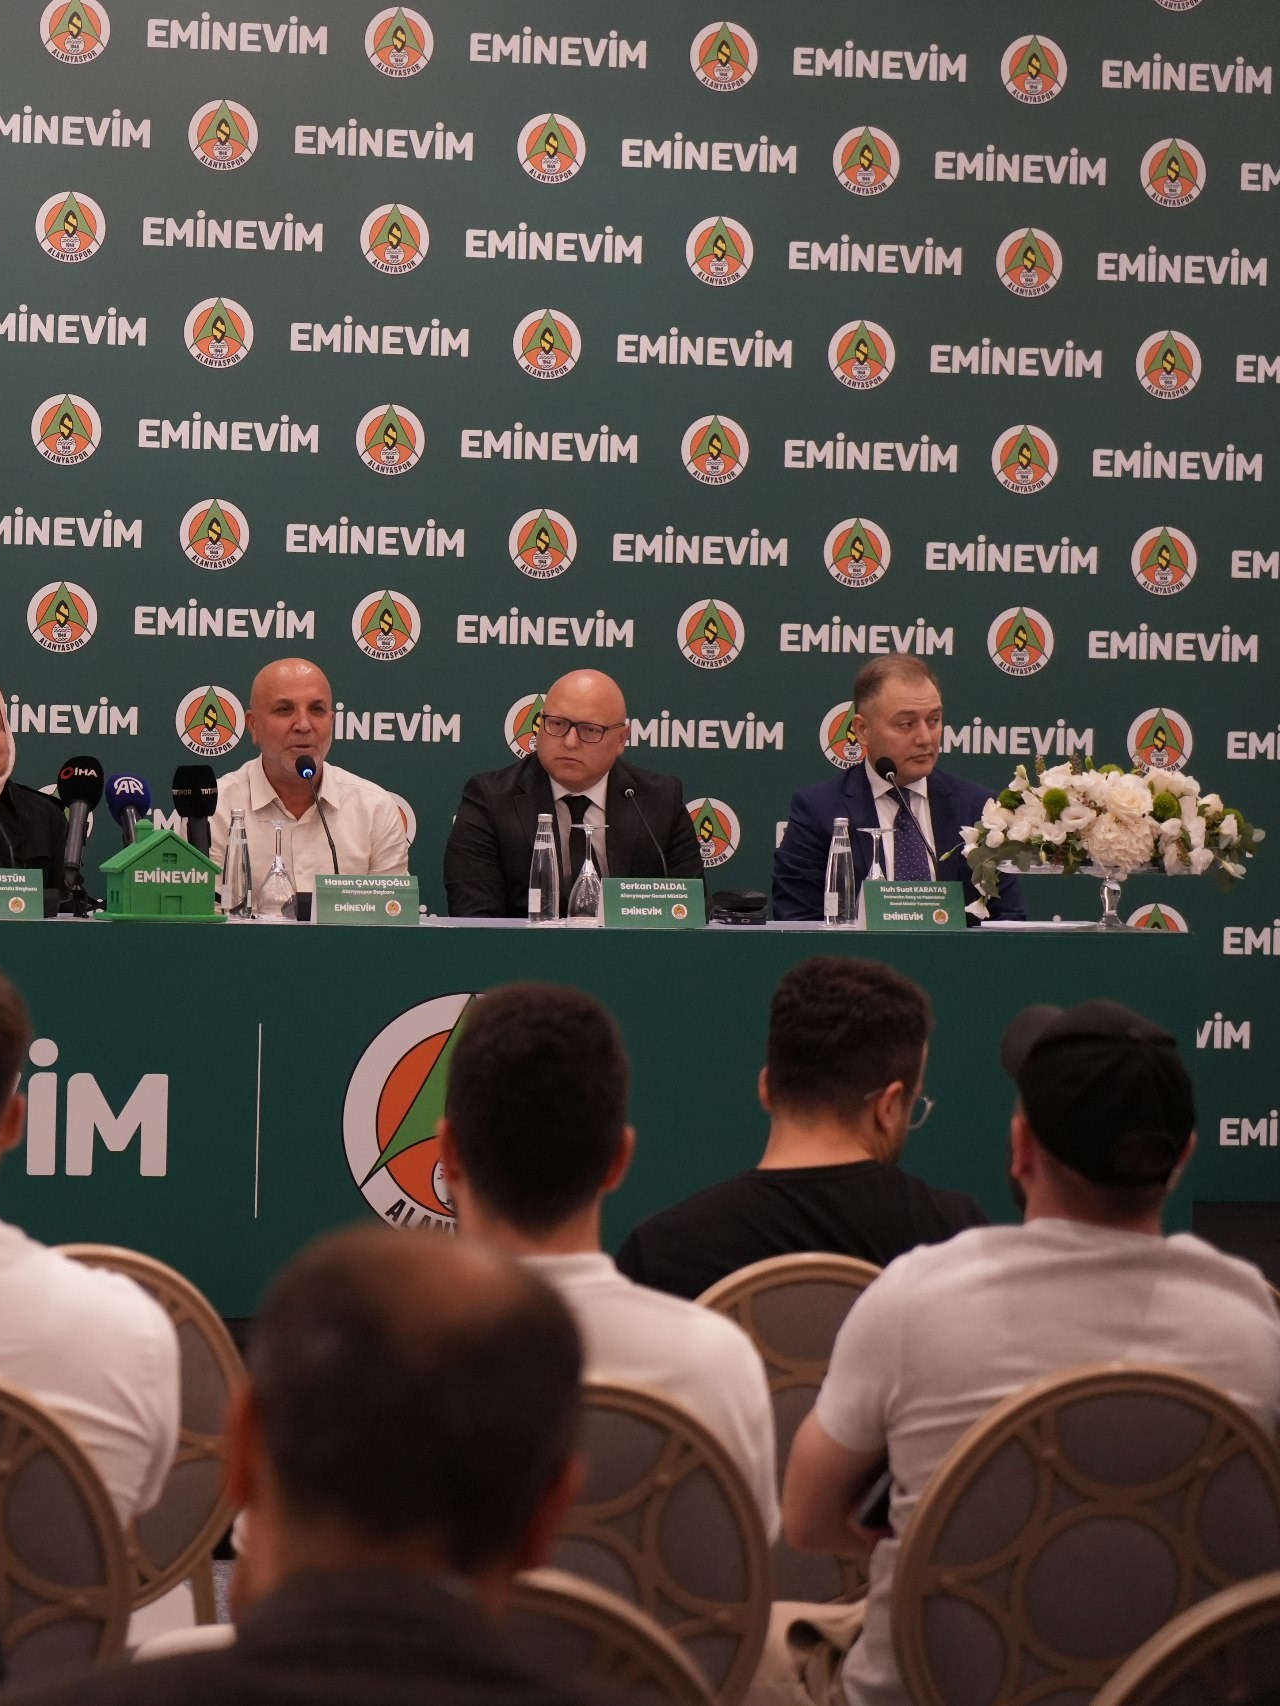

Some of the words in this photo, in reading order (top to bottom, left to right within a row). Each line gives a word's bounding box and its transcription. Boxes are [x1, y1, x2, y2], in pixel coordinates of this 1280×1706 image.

[147, 12, 327, 54] EMİNEVİM
[470, 26, 646, 69] EMİNEVİM
[793, 40, 966, 82] EMİNEVİM
[1102, 53, 1272, 94] EMİNEVİM
[295, 119, 473, 161] EMİNEVİM
[622, 132, 797, 174] EMİNEVİM
[935, 144, 1106, 185] EMİNEVİM
[143, 210, 323, 252] EMİNEVİM
[466, 222, 642, 264] EMİNEVİM
[47, 248, 93, 261] ALANYASPOR
[789, 234, 962, 275] EMİNEVİM
[1097, 245, 1267, 286] EMİNEVİM
[290, 315, 469, 357] EMİNEVİM
[617, 327, 792, 368] EMİNEVİM
[195, 353, 240, 367] ALANYASPOR
[930, 338, 1102, 378] EMİNEVİM
[139, 412, 318, 453] EMİNEVİM
[461, 422, 638, 463] EMİNEVİM
[784, 432, 957, 473] EMİNEVİM
[42, 450, 88, 464] ALANYASPOR
[1093, 442, 1262, 482] EMİNEVİM
[286, 516, 464, 557] EMİNEVİM
[613, 526, 788, 566] EMİNEVİM
[926, 535, 1097, 574] EMİNEVİM
[191, 555, 236, 569] ALANYASPOR
[134, 599, 314, 639] EMİNEVİM
[457, 607, 634, 647] EMİNEVİM
[780, 616, 953, 655] EMİNEVİM
[38, 638, 84, 651] ALANYASPOR
[363, 646, 408, 659] ALANYASPOR
[1089, 623, 1258, 662] EMİNEVİM
[5, 695, 138, 735] İNEVİM
[335, 702, 460, 742] İNEVİM
[187, 742, 233, 755] ALANYASPOR
[939, 717, 1093, 756] MİNEVİM
[74, 767, 98, 778] İHA
[134, 867, 209, 883] EMİNEVİM
[356, 879, 410, 888] ÇAVUŞOĞLU
[335, 902, 375, 911] EMİNEVİM
[622, 906, 662, 915] EMİNEVİM
[883, 912, 923, 920] EMİNEVİM
